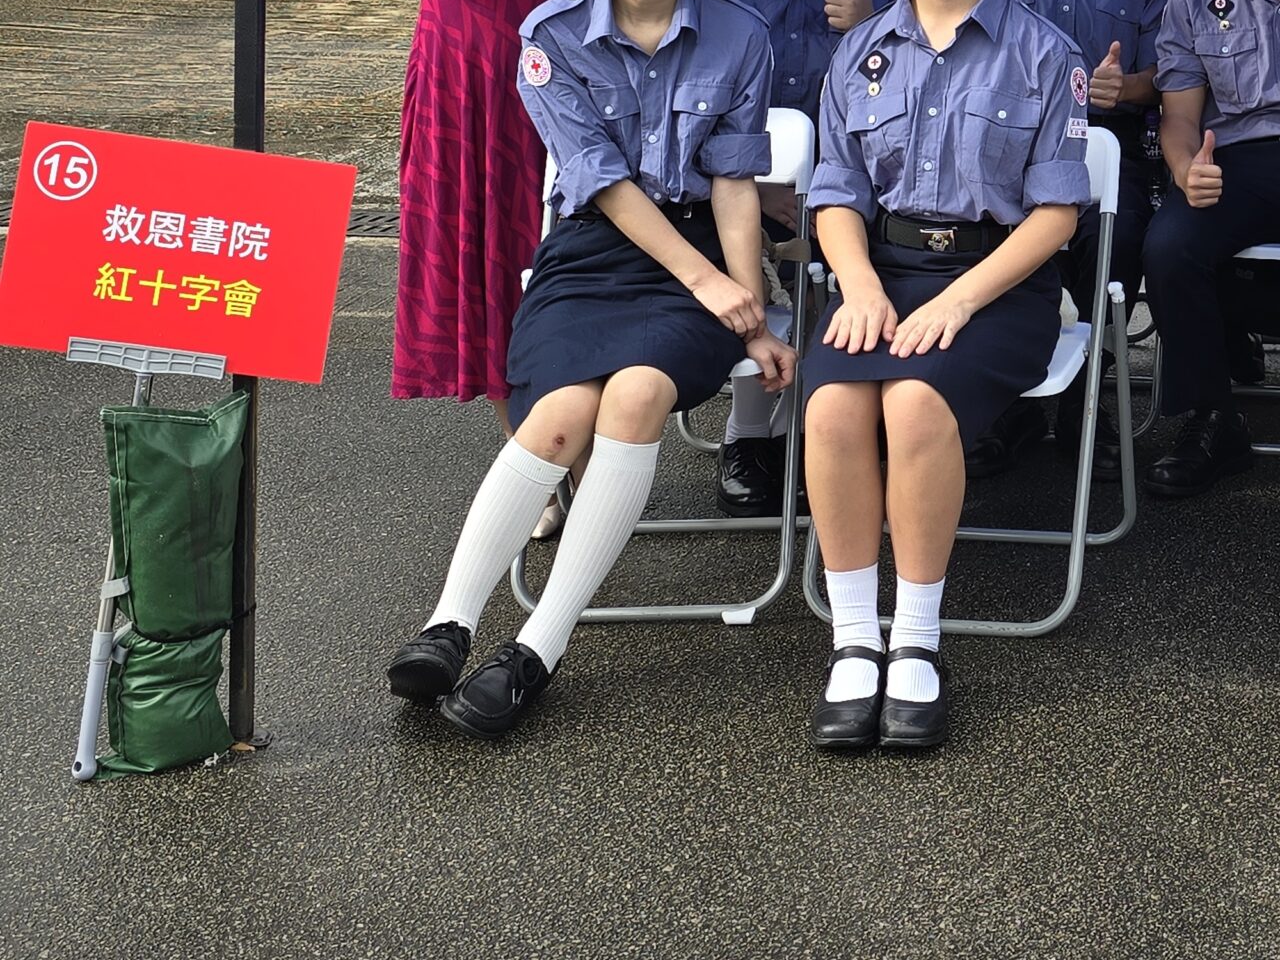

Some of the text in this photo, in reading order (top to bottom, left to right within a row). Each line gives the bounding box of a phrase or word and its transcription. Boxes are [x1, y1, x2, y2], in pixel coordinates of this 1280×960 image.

[42, 153, 90, 190] 15
[102, 204, 271, 261] 救恩書院
[93, 262, 262, 318] 紅十字會
